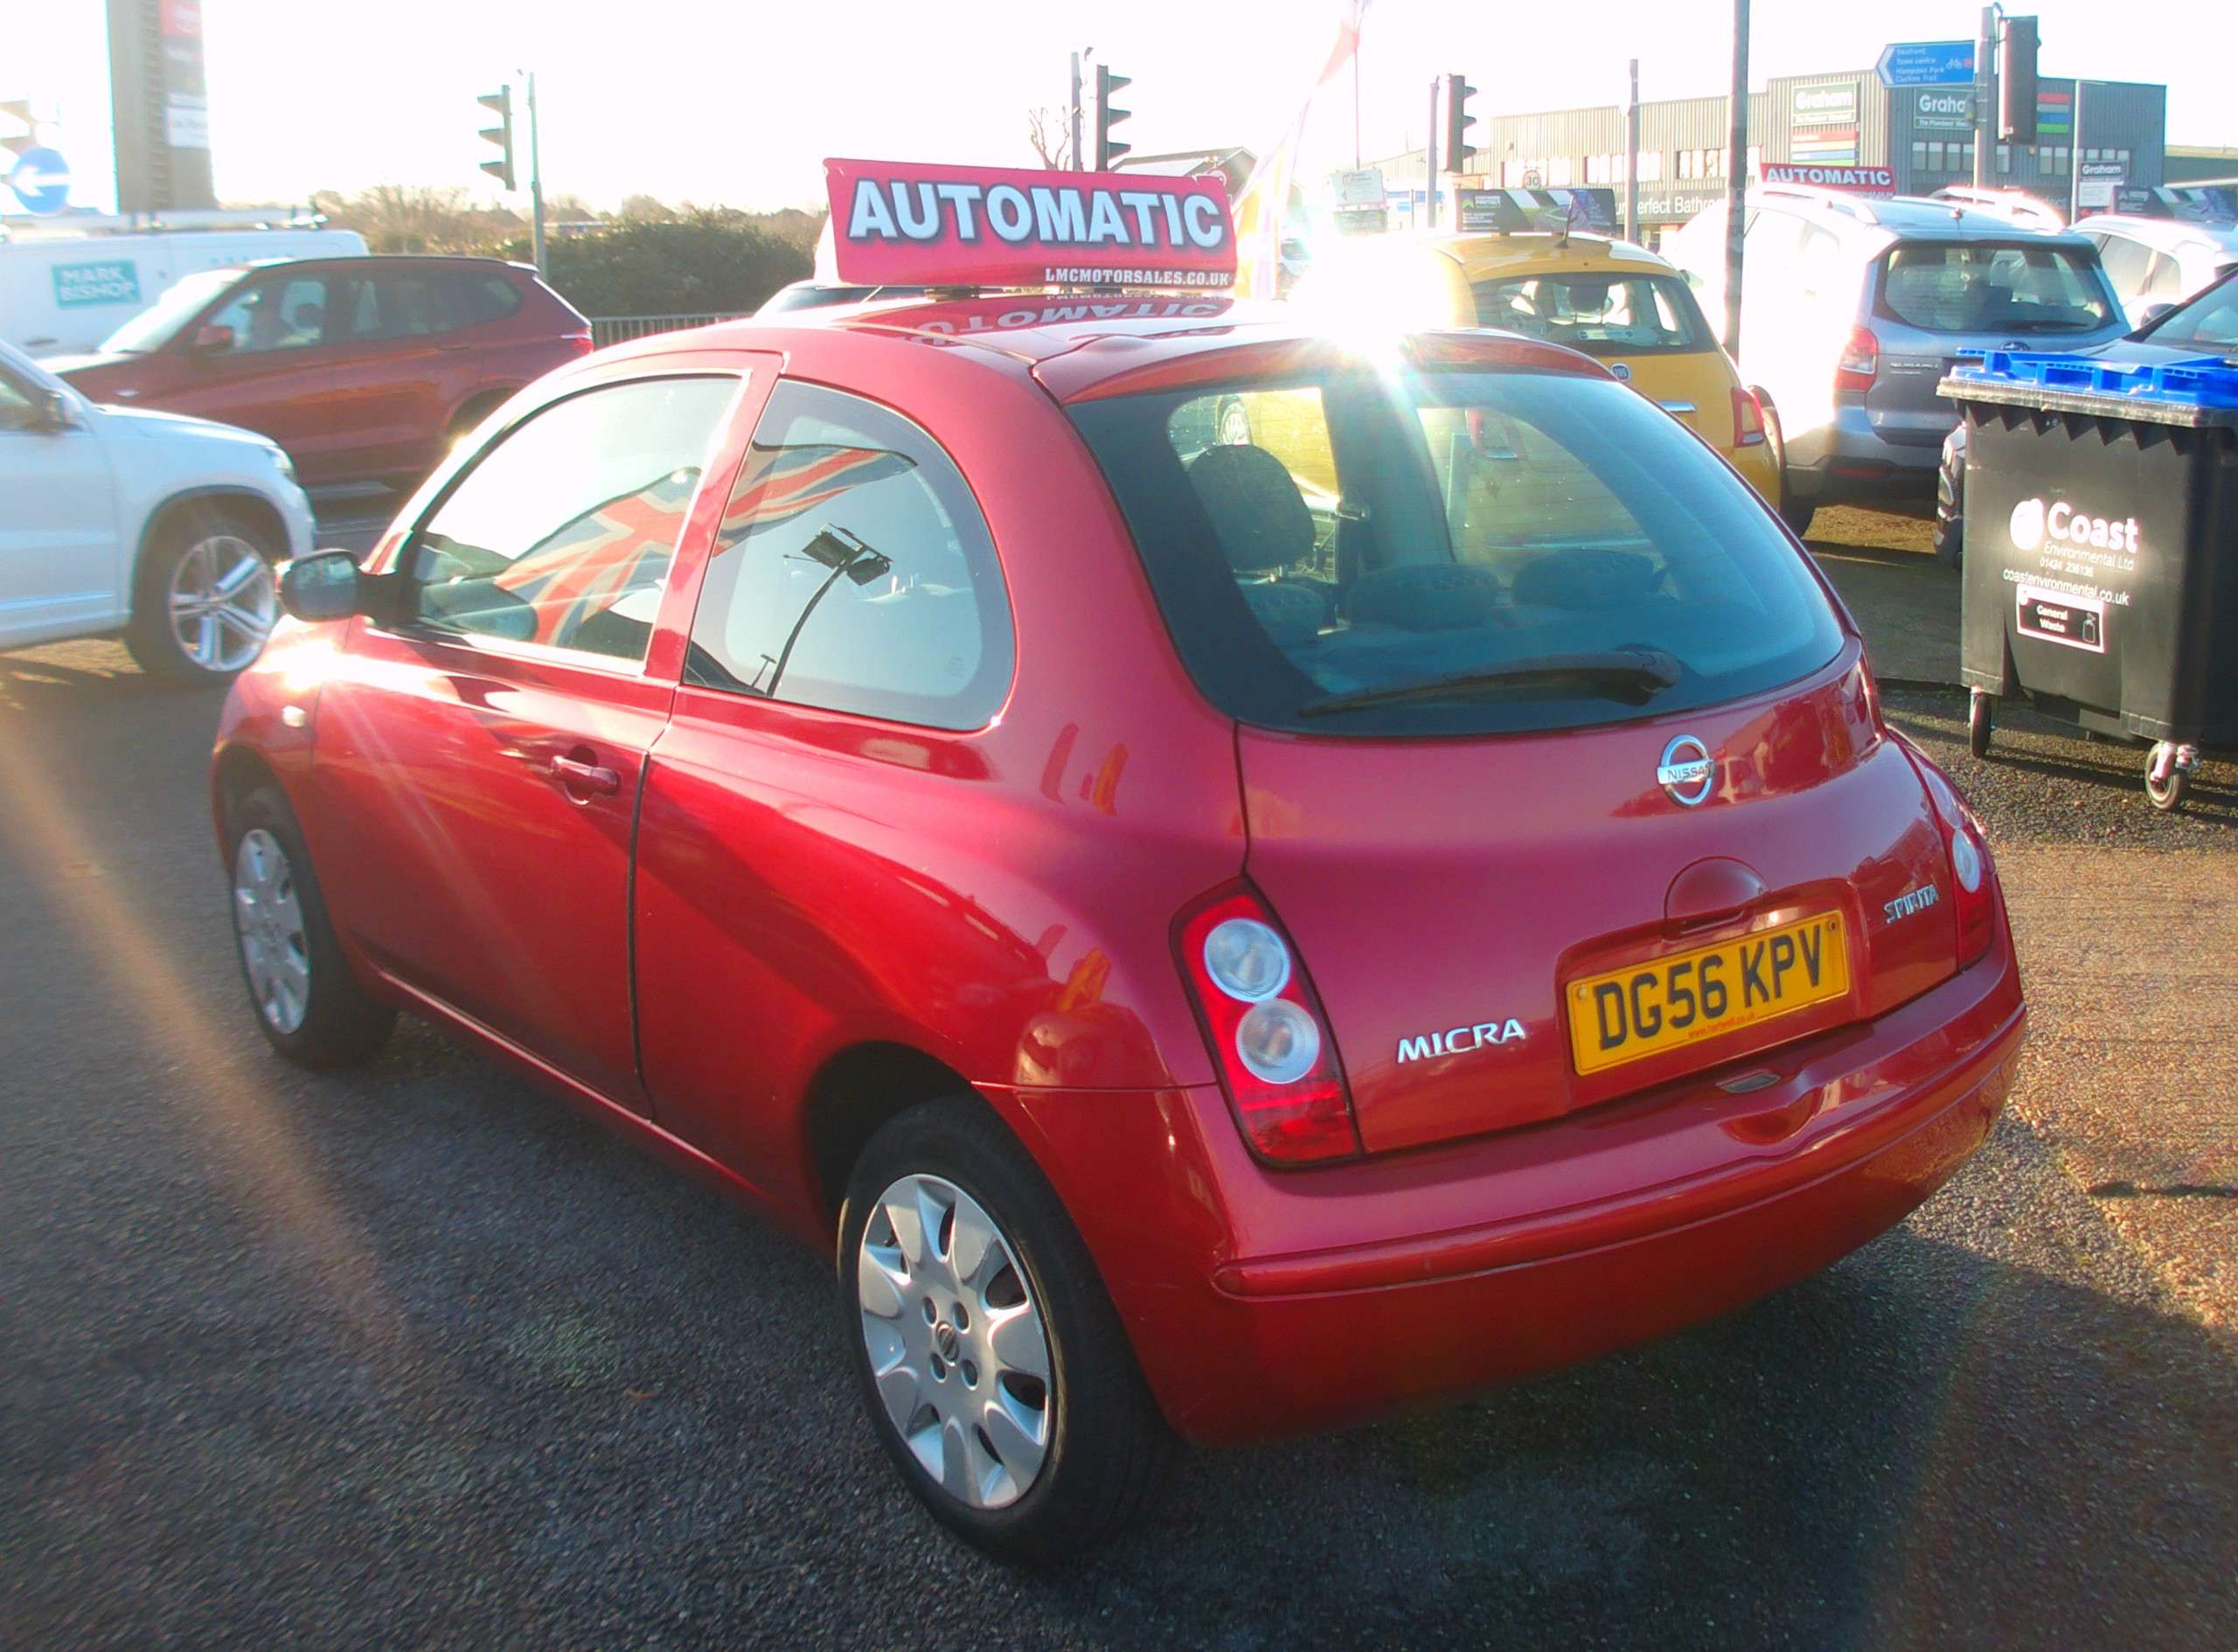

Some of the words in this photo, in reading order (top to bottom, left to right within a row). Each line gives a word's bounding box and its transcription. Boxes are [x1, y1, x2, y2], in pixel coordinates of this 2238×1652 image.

[1919, 94, 1966, 113] Graha
[1766, 167, 1891, 186] AUTOMATIC
[2082, 164, 2122, 175] Graham
[1526, 177, 1539, 186] 30
[849, 180, 1224, 248] AUTOMATIC
[1637, 197, 1672, 215] erfect
[61, 267, 126, 284] MARK
[1045, 267, 1229, 286] LMCMOTORSALES.CO.UK
[60, 281, 136, 302] BISHOP
[2047, 502, 2139, 554] Coast
[2043, 540, 2116, 567] Environmental
[2117, 555, 2135, 571] Ltd
[2003, 568, 2130, 606] coastenvironmental.co.uk
[2036, 604, 2068, 621] General
[2040, 618, 2067, 634] Waste
[1593, 954, 1727, 1051] DG56
[1740, 924, 1820, 1008] KPV
[1397, 1018, 1526, 1064] MICRA
